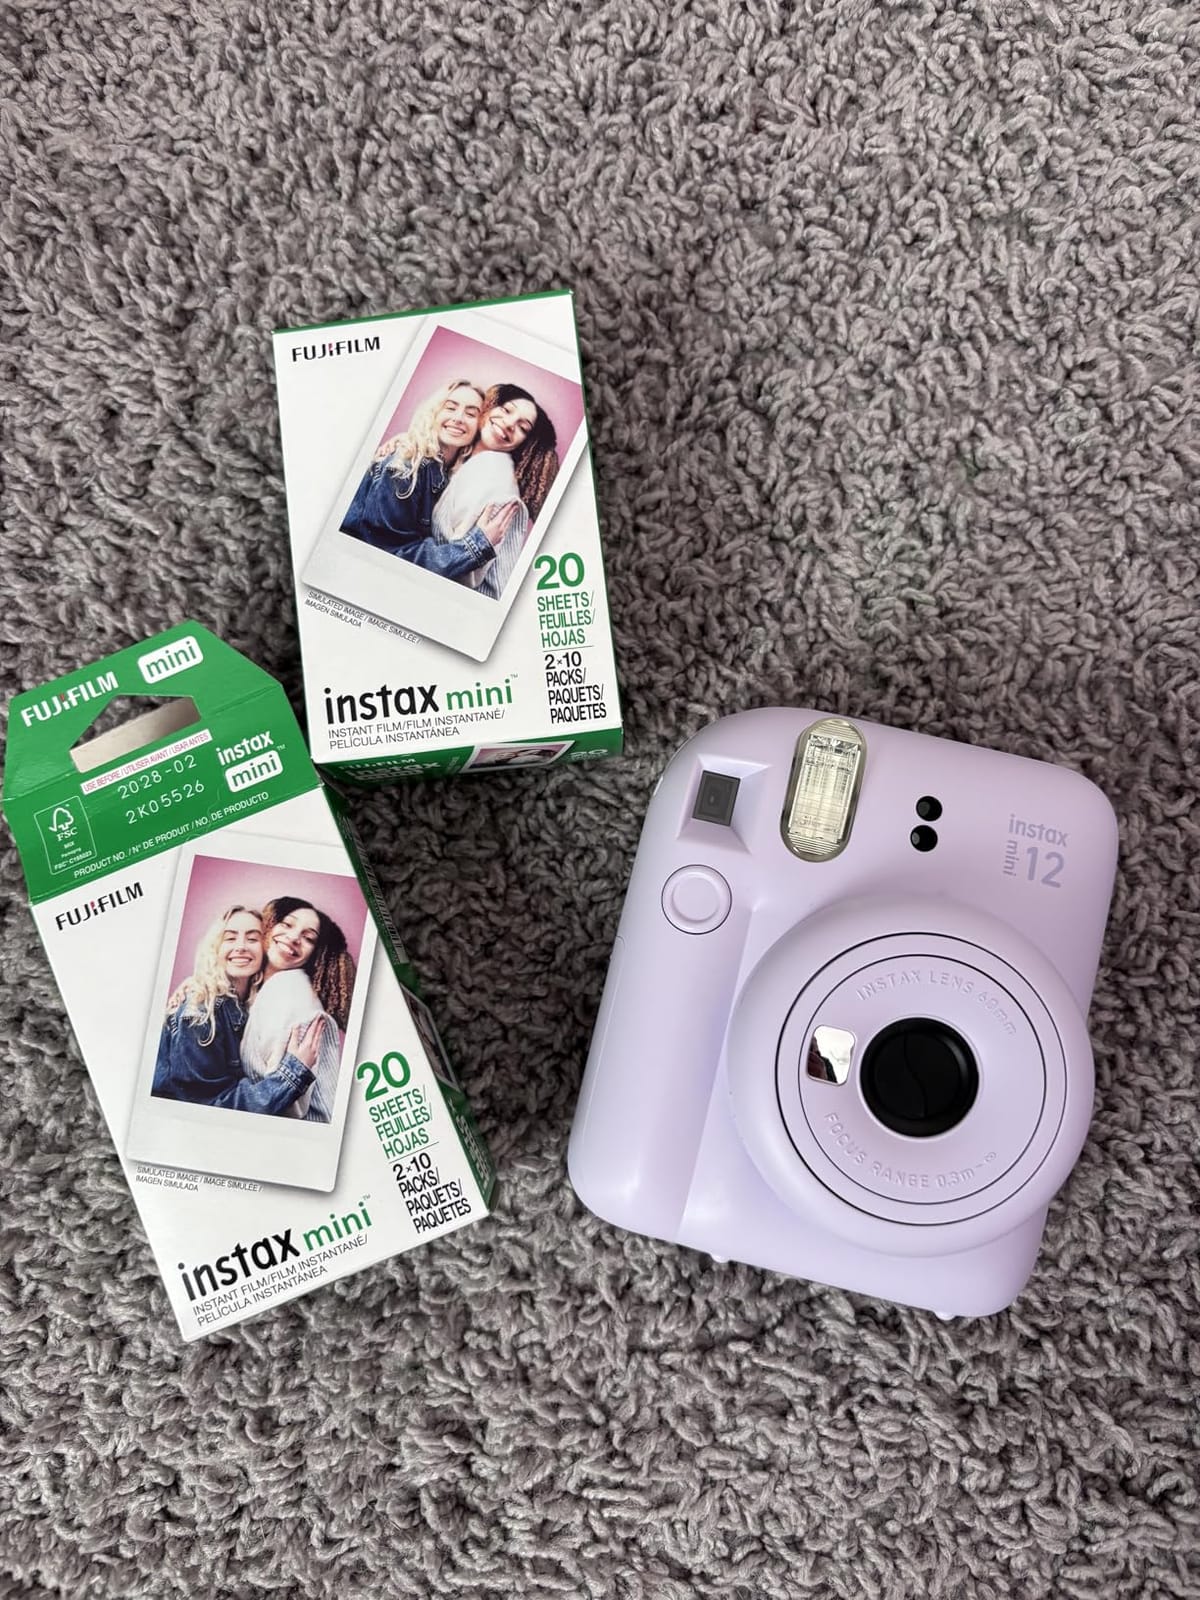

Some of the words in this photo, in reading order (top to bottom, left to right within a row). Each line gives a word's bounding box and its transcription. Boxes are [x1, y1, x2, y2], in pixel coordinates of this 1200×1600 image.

[292, 336, 380, 362] FUJIFILM
[534, 552, 585, 590] 20
[305, 599, 330, 614] IMAGEN
[330, 609, 362, 627] SIMULADA
[308, 591, 343, 611] SIMULATED
[343, 607, 366, 621] IMAGE
[368, 616, 389, 631] IMAGE
[537, 590, 595, 612] SHEETS/
[539, 608, 596, 631] FEUILLES/
[541, 629, 586, 648] HOJAS
[20, 671, 119, 727] FUJIFILM
[146, 641, 197, 677] mini
[546, 667, 587, 687] PACKS/
[324, 684, 439, 725] instax
[446, 678, 513, 710] mini
[548, 684, 604, 706] PAQUETS/
[550, 703, 607, 724] PAQUETES
[216, 731, 274, 766] instax
[328, 724, 374, 739] INSTANT
[329, 735, 382, 750] PELÍCULA
[385, 726, 460, 744] INSTANTÁNEA
[84, 782, 97, 792] USE
[97, 772, 121, 788] BEFORE
[122, 759, 151, 775] UTILISER
[150, 751, 169, 764] AVANT
[172, 741, 189, 754] USAR
[188, 732, 209, 746] ANTES
[117, 754, 197, 800] 2028-02
[232, 754, 277, 787] mini
[125, 780, 205, 824] 2K05526
[57, 827, 78, 841] FSC
[74, 854, 113, 878] PRODUCT
[113, 849, 129, 862] NO.
[143, 840, 155, 851] DE
[155, 823, 190, 845] PRODUIT
[195, 816, 211, 827] NO.
[211, 810, 224, 821] DE
[224, 791, 269, 815] PRODUCTO
[1008, 813, 1069, 847] instax
[1002, 839, 1020, 877] mini
[1026, 846, 1065, 888] 12
[55, 881, 143, 931] FUJIFILM
[856, 970, 921, 1000] INSTAX
[929, 970, 974, 994] LENS
[356, 1051, 411, 1101] 20
[369, 1084, 426, 1123] SHEETS/
[375, 1102, 432, 1141] FEUILLES/
[383, 1127, 430, 1159] HOJAS
[824, 1112, 867, 1164] FOCUS
[871, 1161, 929, 1188] RANGE
[135, 1175, 161, 1186] IMAGEN
[163, 1179, 199, 1191] SIMULADA
[136, 1166, 176, 1178] SIMULATED
[176, 1172, 200, 1183] IMAGE
[203, 1176, 226, 1187] IMAGE
[398, 1167, 440, 1199] PACKS/
[406, 1178, 462, 1217] PAQUETS/
[413, 1198, 471, 1234] PAQUETES
[178, 1228, 301, 1301] instax
[302, 1201, 372, 1251] mini
[192, 1290, 238, 1316] INSTANT
[197, 1299, 252, 1326] PELÍCULA
[253, 1265, 328, 1302] INSTANTÁNEA
